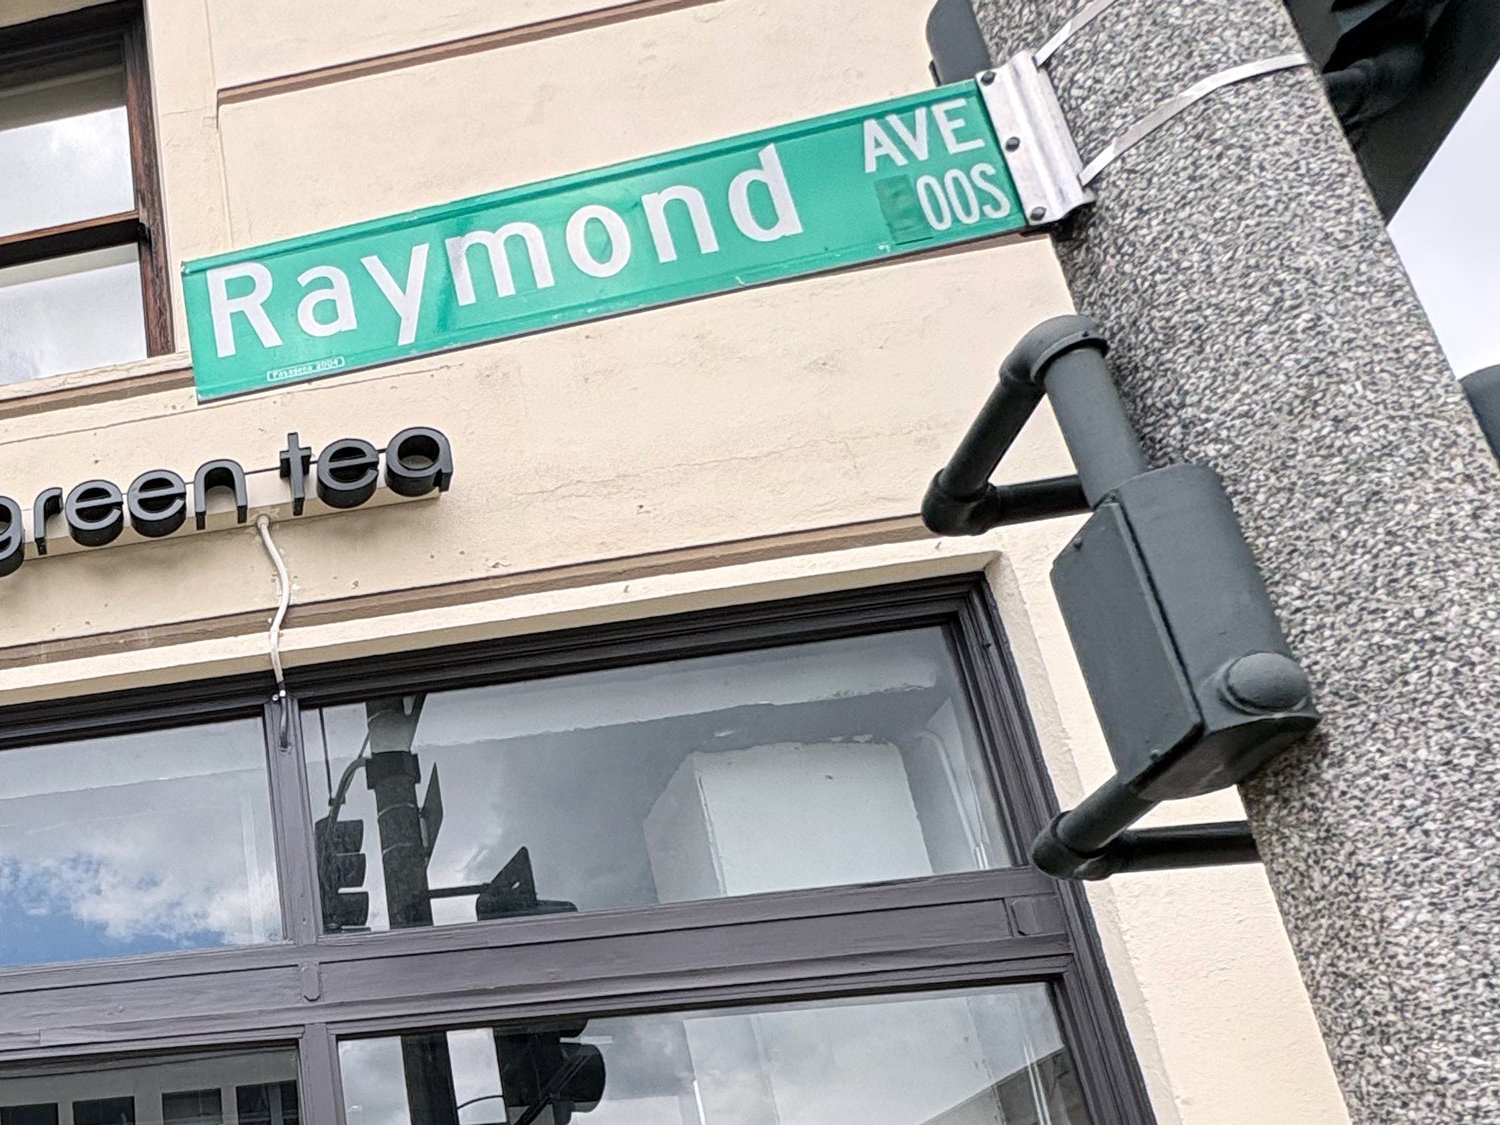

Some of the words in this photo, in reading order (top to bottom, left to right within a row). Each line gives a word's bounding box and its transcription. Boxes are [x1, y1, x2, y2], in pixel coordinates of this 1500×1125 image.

[862, 98, 987, 175] AVE
[915, 162, 1013, 233] 00S
[205, 142, 803, 358] Raymond
[280, 425, 453, 517] tea
